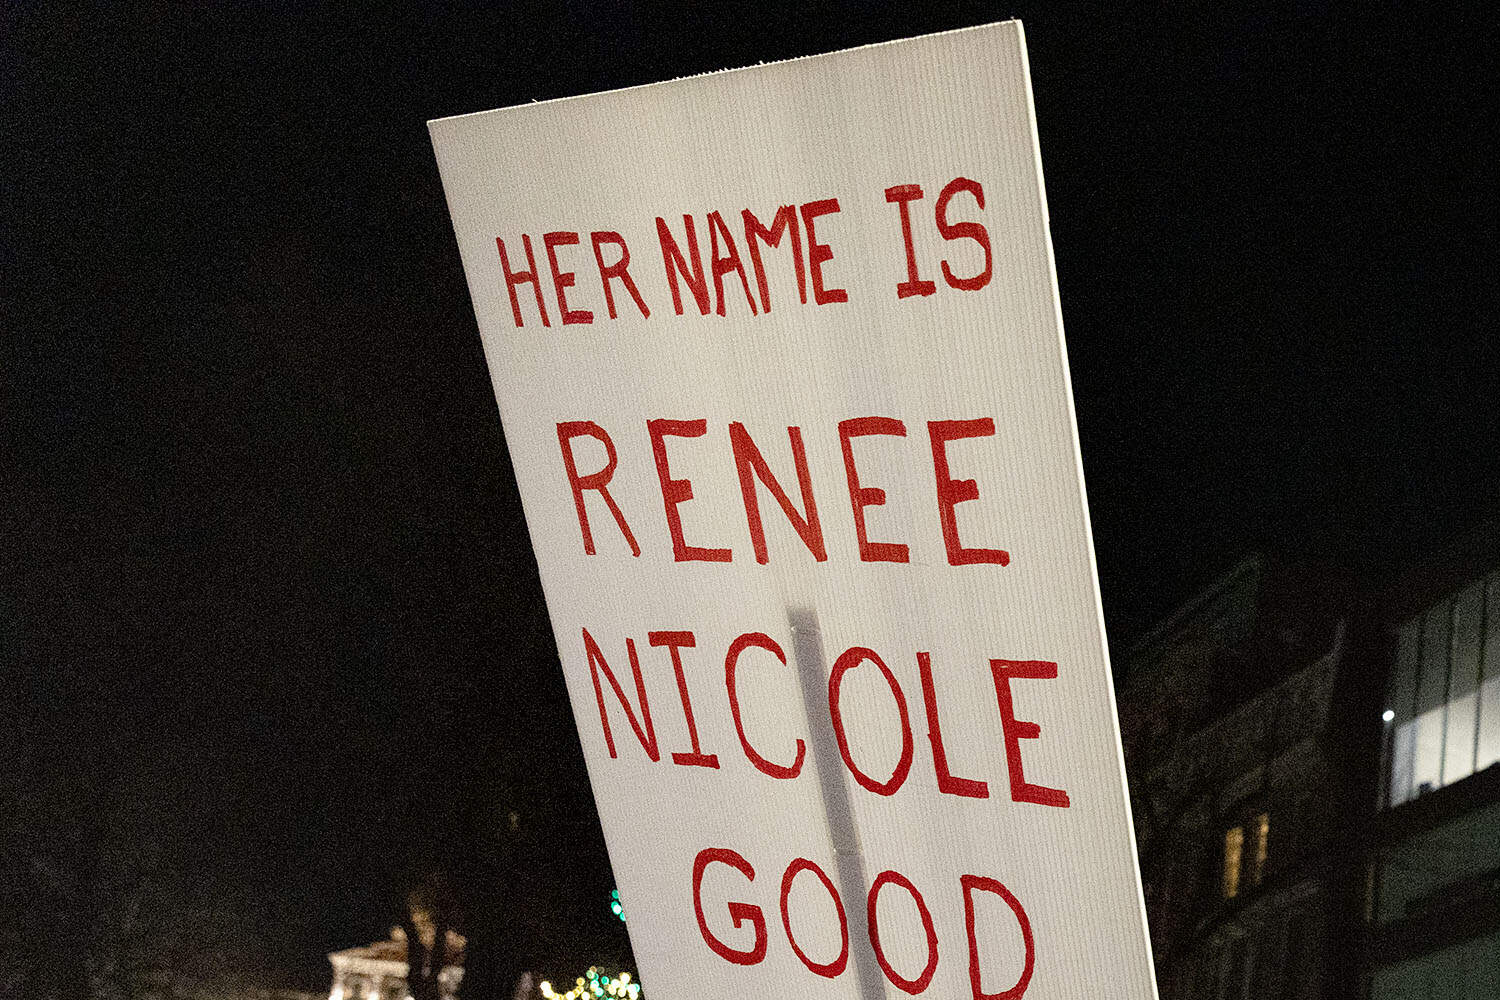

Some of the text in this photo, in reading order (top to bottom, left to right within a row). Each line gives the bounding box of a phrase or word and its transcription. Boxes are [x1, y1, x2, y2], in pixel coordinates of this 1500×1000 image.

[496, 177, 993, 327] HER NAME IS
[556, 417, 1010, 567] RENEE
[582, 627, 1071, 808] NICOLE
